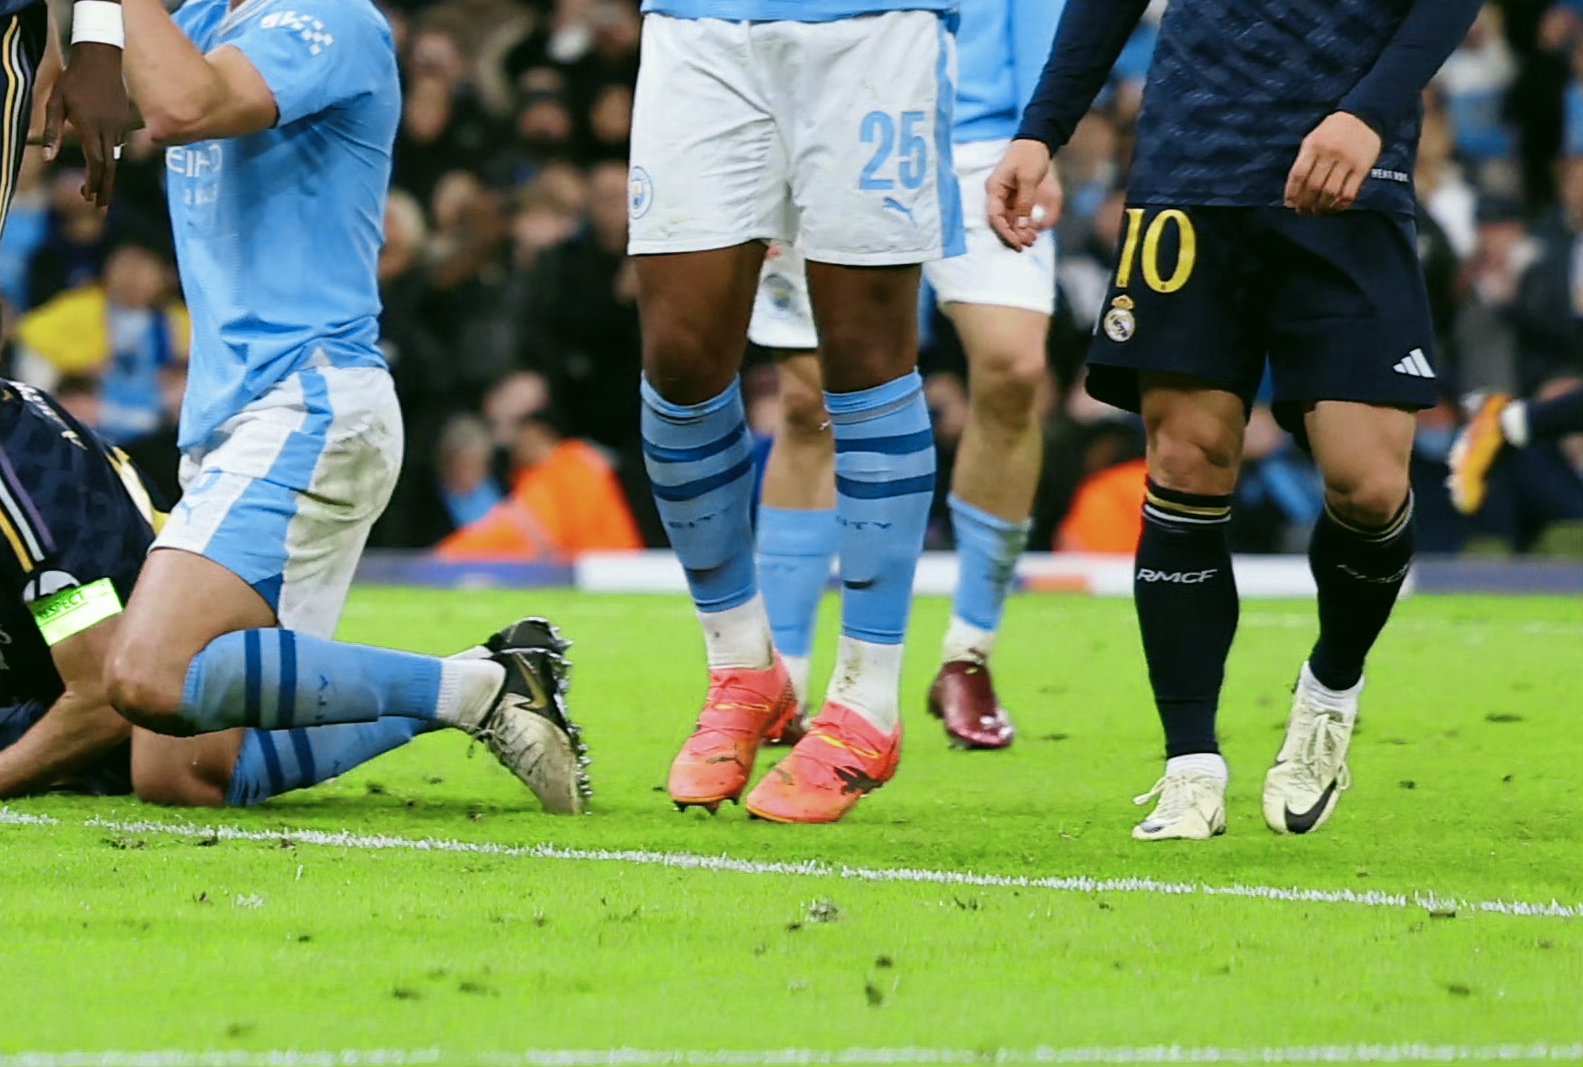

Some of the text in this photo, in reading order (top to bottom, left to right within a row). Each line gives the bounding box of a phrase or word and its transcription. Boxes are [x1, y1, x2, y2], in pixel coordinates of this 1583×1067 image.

[857, 109, 928, 191] 25
[1115, 206, 1198, 295] 10
[1136, 567, 1218, 584] RMCF
